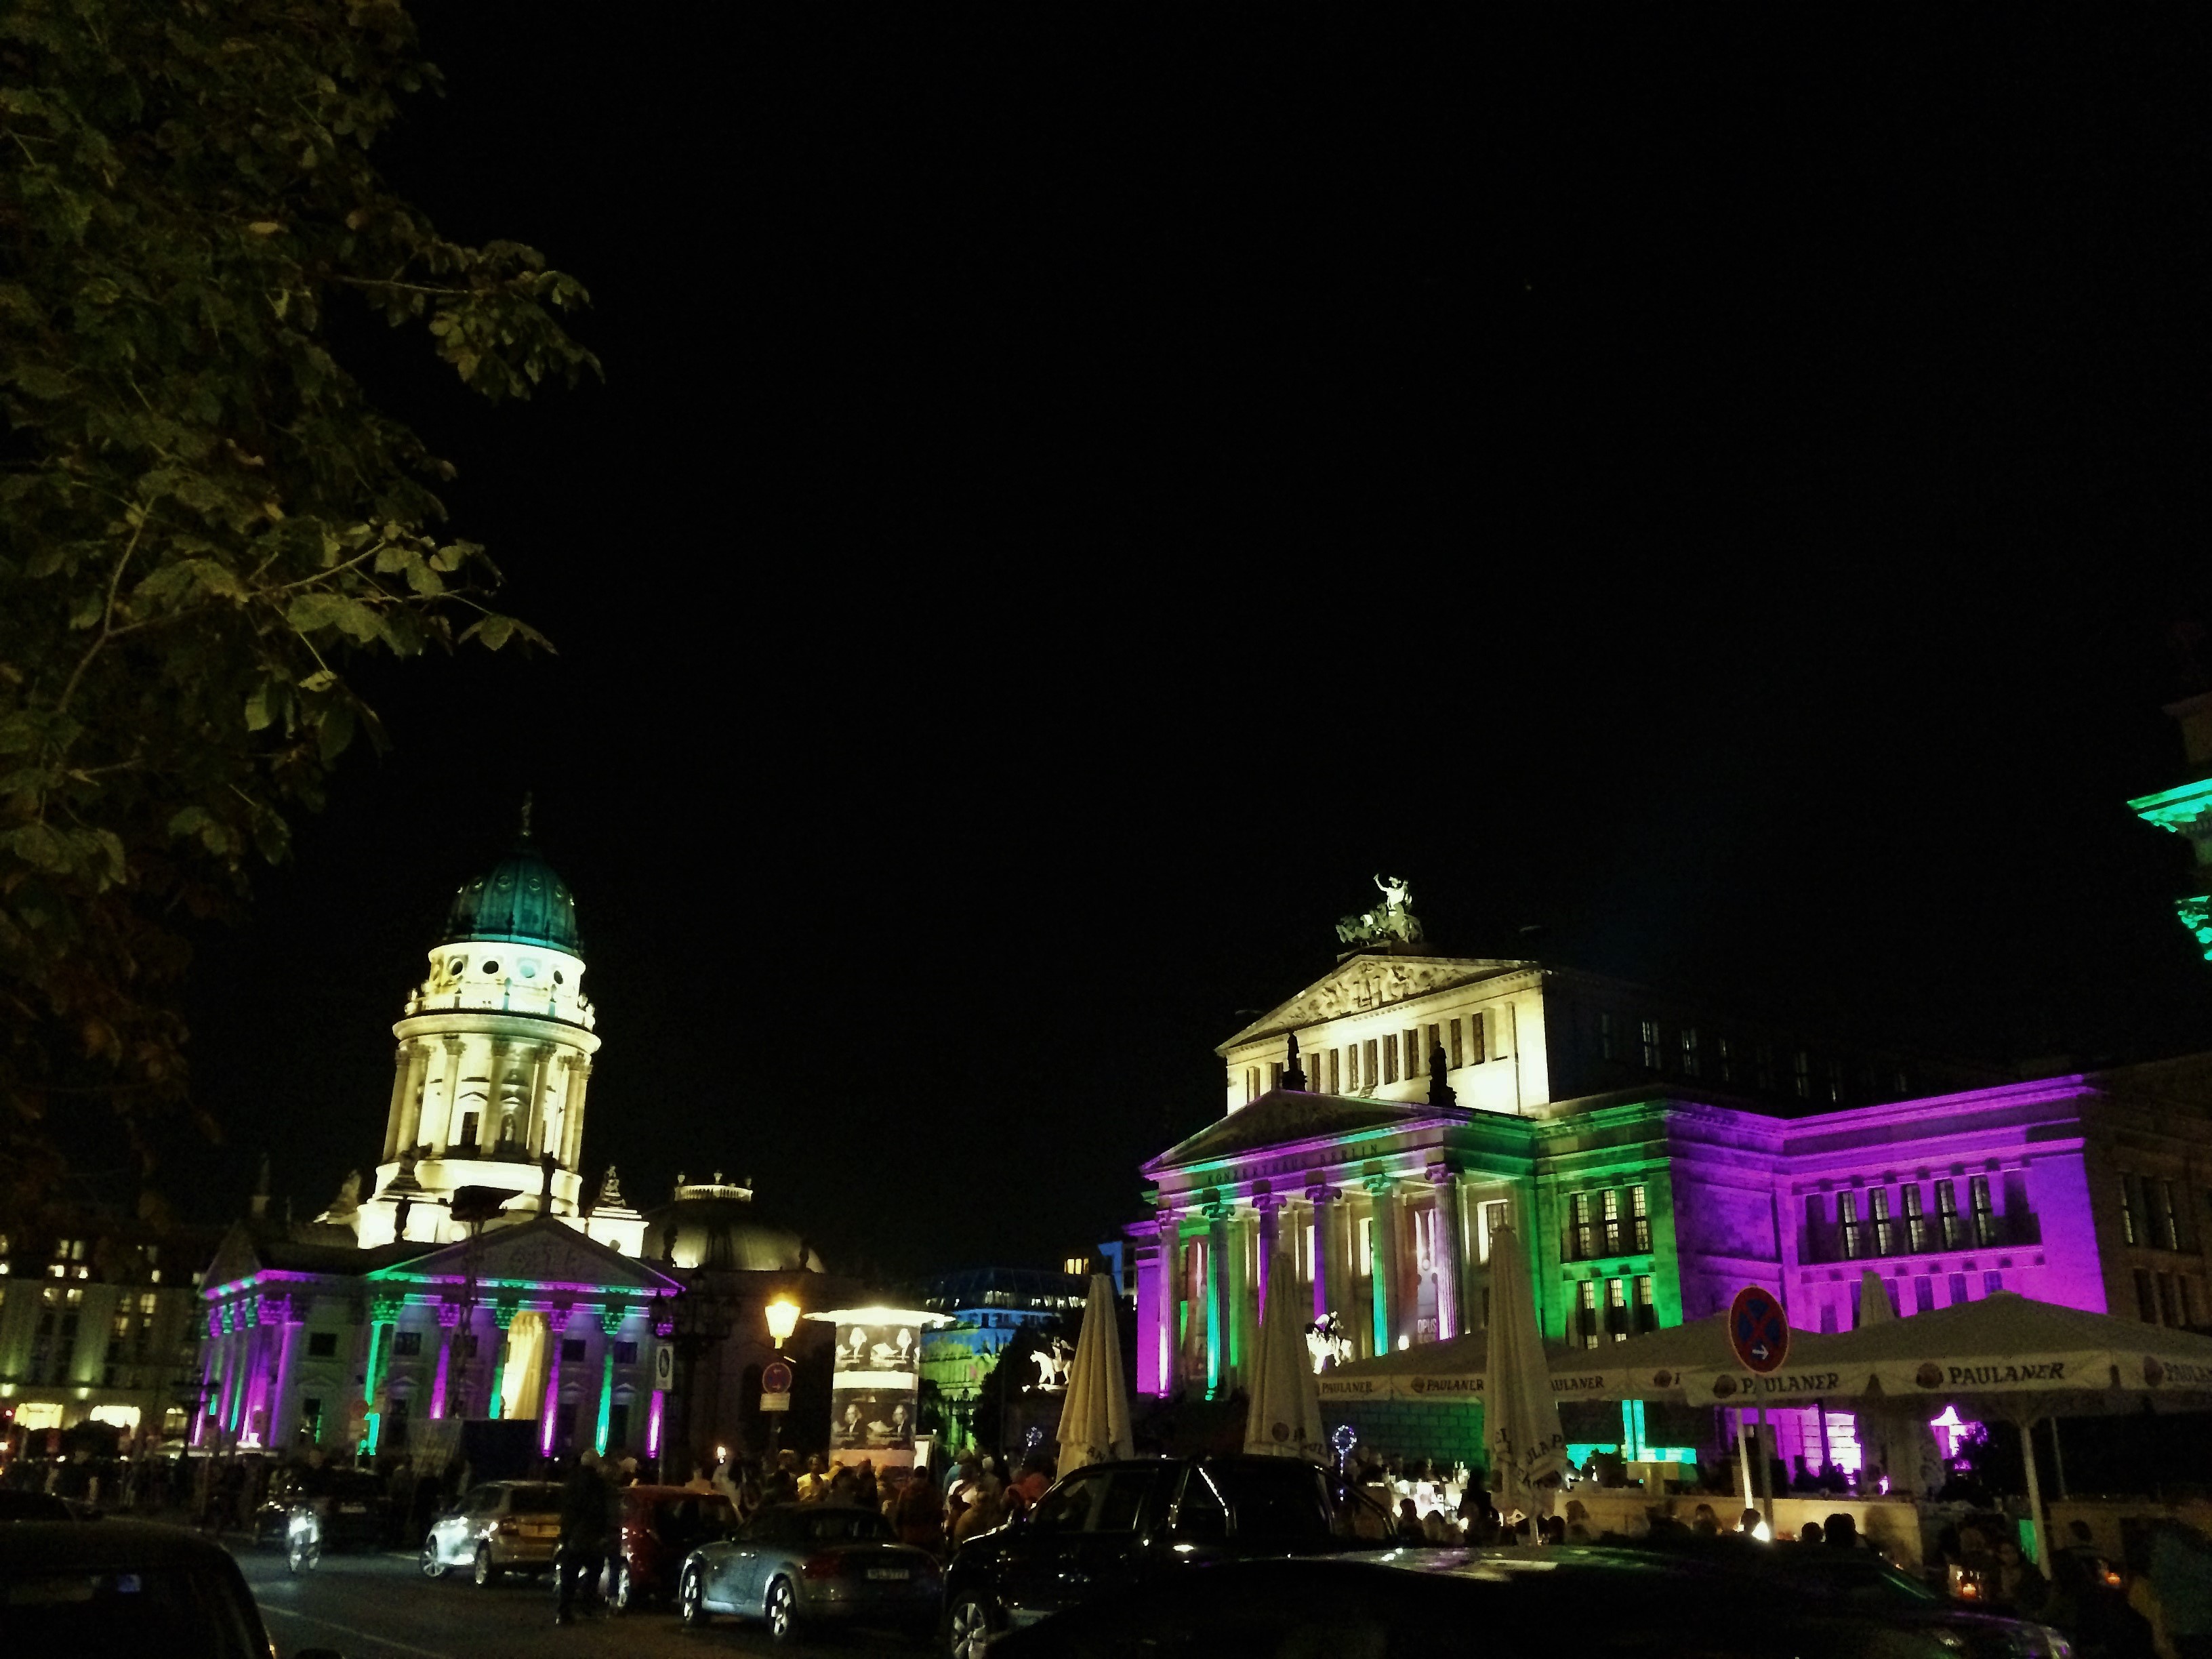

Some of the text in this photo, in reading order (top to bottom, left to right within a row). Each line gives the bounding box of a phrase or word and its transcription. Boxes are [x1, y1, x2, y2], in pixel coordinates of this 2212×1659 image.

[1948, 1361, 2065, 1385] PAULANER
[1322, 1381, 1374, 1394] PAULANER
[1427, 1378, 1485, 1391] PAULANER
[1740, 1372, 1839, 1394] PULANER
